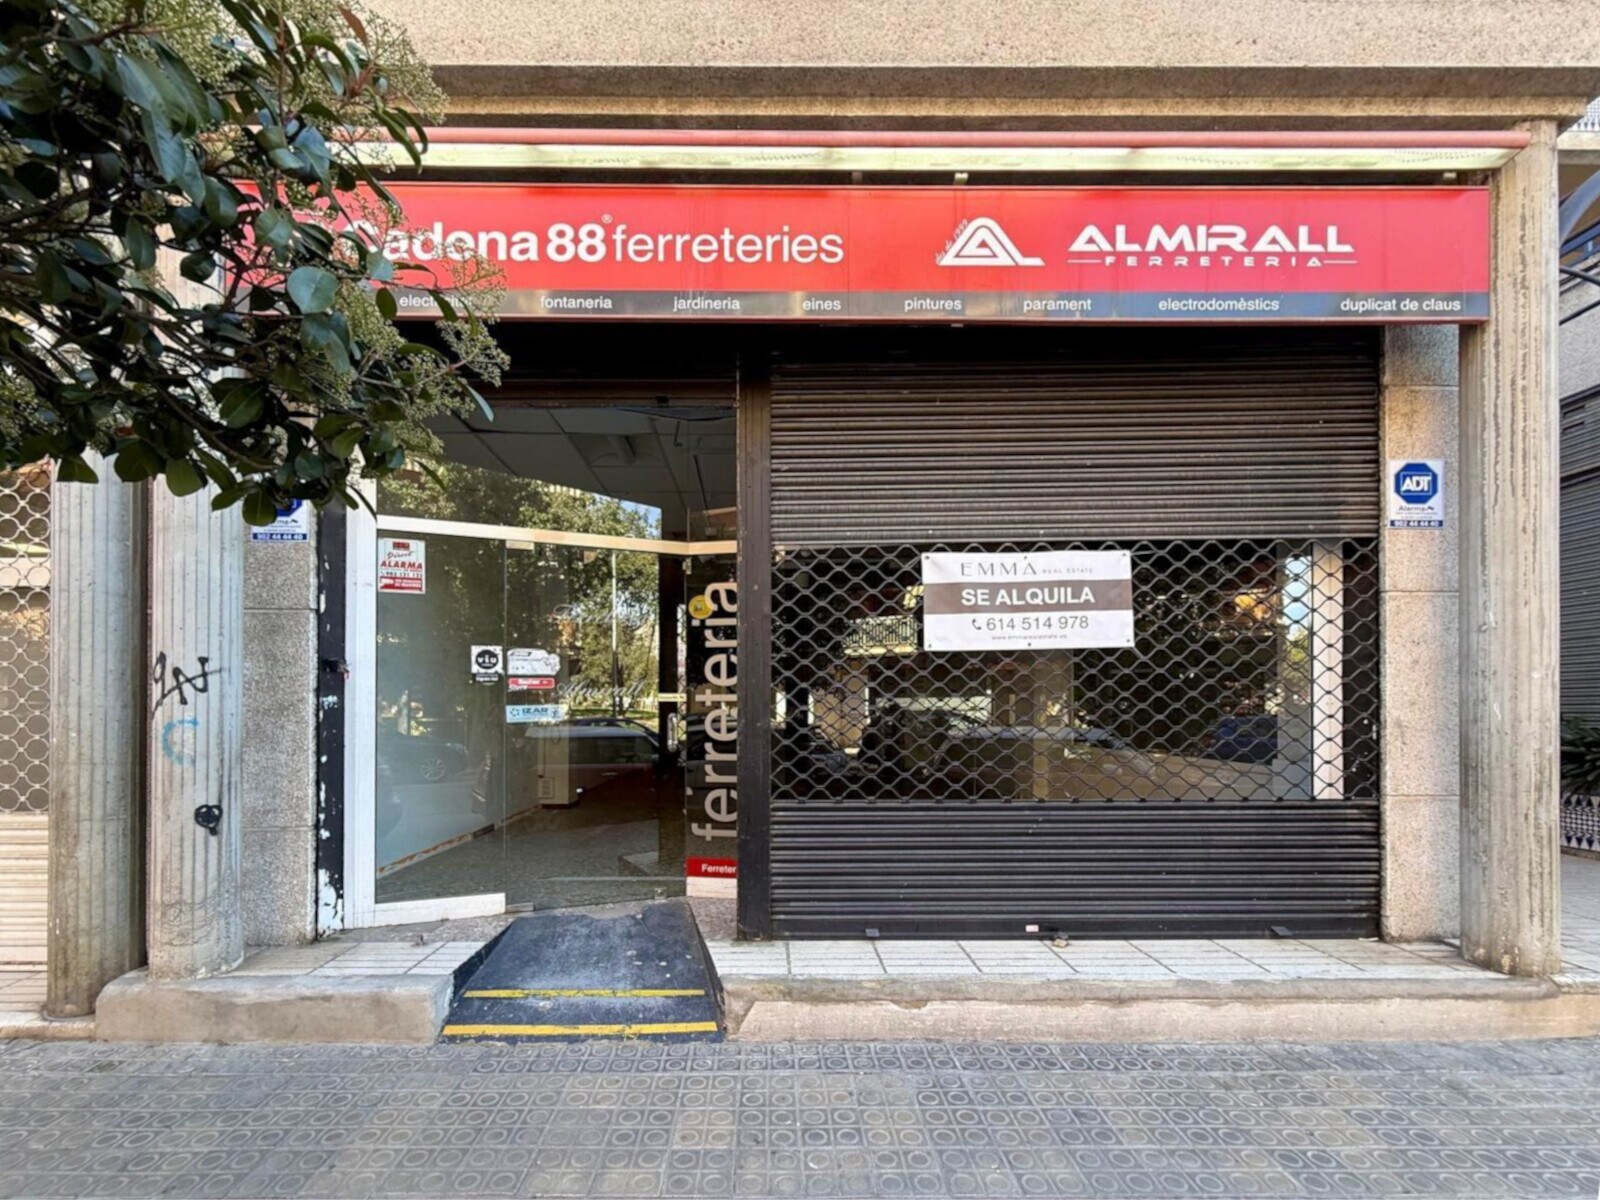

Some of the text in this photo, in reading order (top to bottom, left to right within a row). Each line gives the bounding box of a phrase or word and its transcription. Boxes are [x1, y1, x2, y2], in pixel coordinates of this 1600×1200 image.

[612, 224, 844, 263] ferreteries
[1068, 224, 1355, 253] ALMIRALL
[1105, 256, 1322, 267] FERRETERIA
[540, 296, 613, 310] fontaneria
[672, 297, 740, 312] jardineria
[802, 299, 842, 311] eines
[904, 299, 962, 312] pintures
[1023, 299, 1092, 313] parament
[1158, 297, 1280, 312] electrodomèstics
[1340, 299, 1461, 314] duplicat de claus
[1401, 475, 1432, 492] ADT
[380, 560, 423, 570] ALARMA
[961, 562, 1037, 577] EMMA
[961, 586, 1095, 606] SE ALQUILA
[986, 615, 1089, 631] 614 514 978
[691, 581, 738, 842] ferreteria
